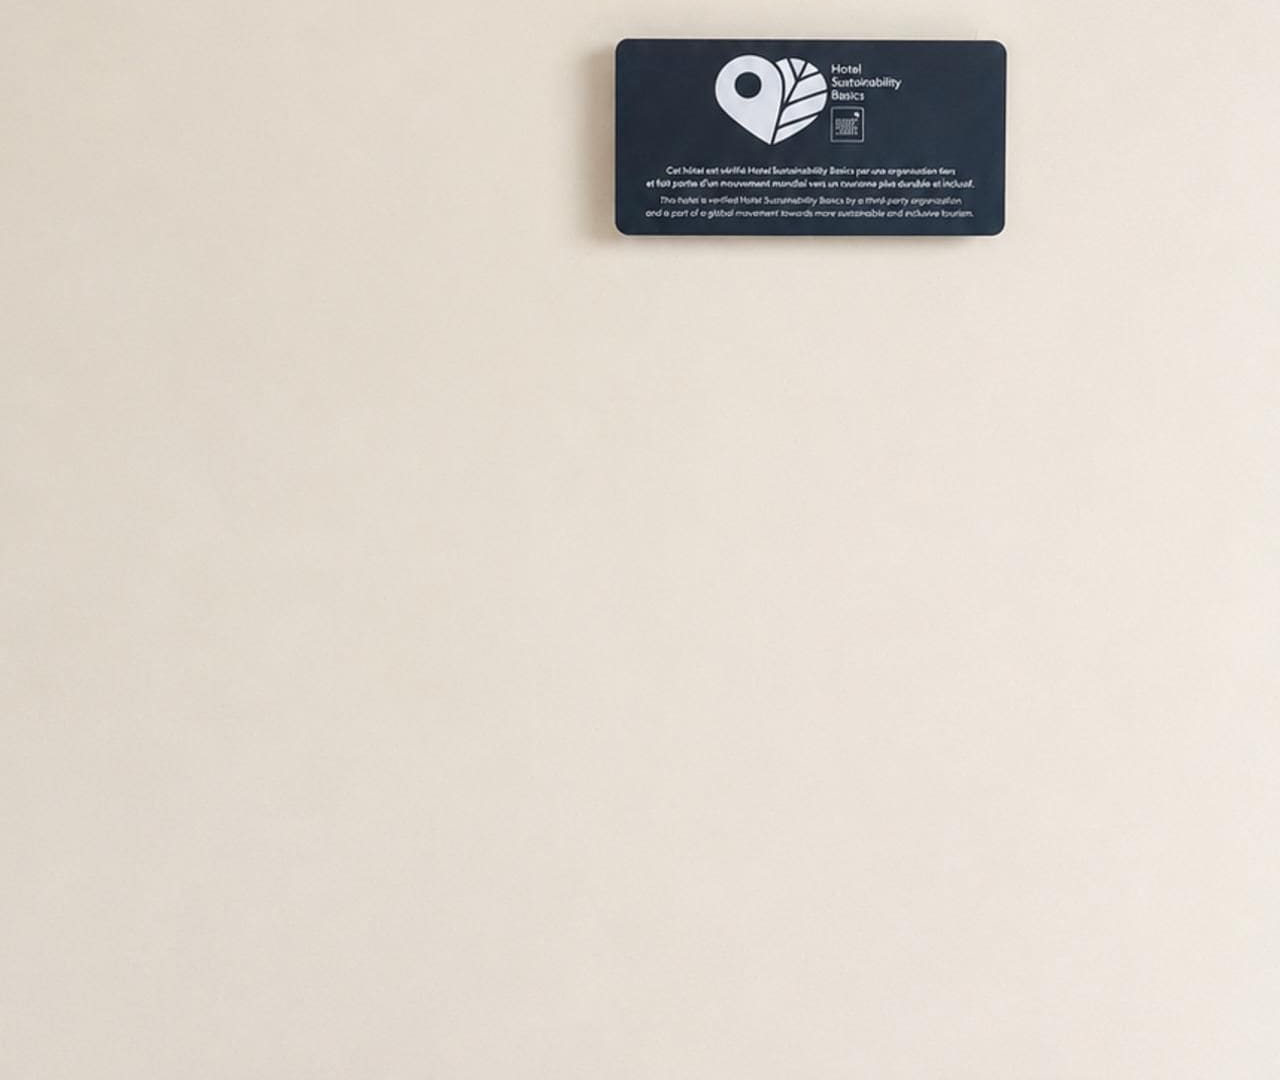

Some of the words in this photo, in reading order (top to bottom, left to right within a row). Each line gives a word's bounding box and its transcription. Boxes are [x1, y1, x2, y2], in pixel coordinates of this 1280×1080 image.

[831, 64, 862, 75] Hotel
[831, 76, 902, 91] Sustainability
[831, 89, 865, 101] Basics
